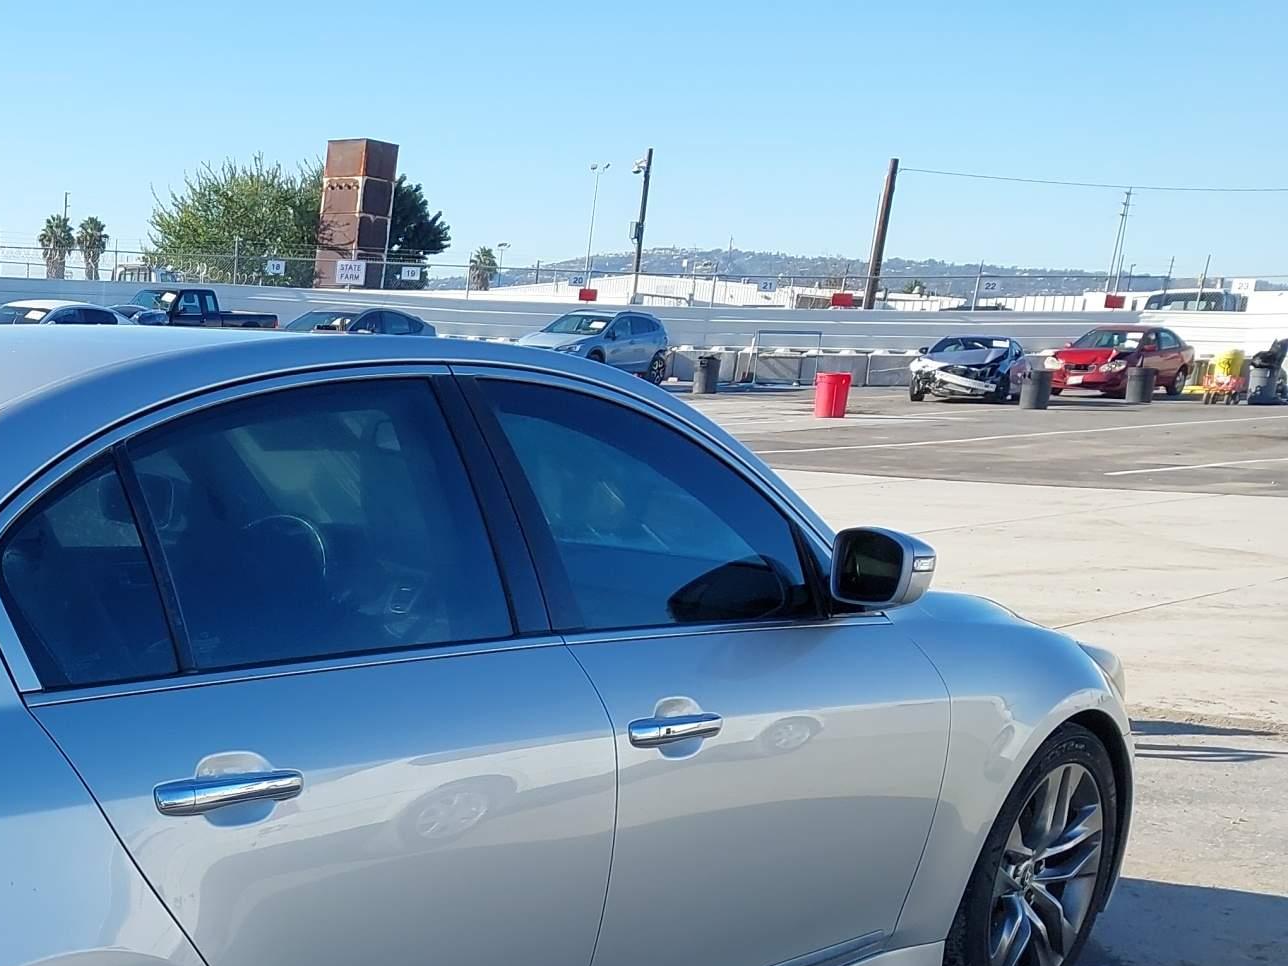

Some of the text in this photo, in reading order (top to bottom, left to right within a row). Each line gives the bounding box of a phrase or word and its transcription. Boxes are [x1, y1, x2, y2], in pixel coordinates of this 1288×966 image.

[271, 263, 281, 271] 18
[340, 264, 361, 272] STATE
[340, 273, 360, 281] FARM
[572, 276, 584, 285] 20
[762, 281, 773, 290] 21
[985, 282, 997, 290] 22
[1237, 281, 1249, 290] 23
